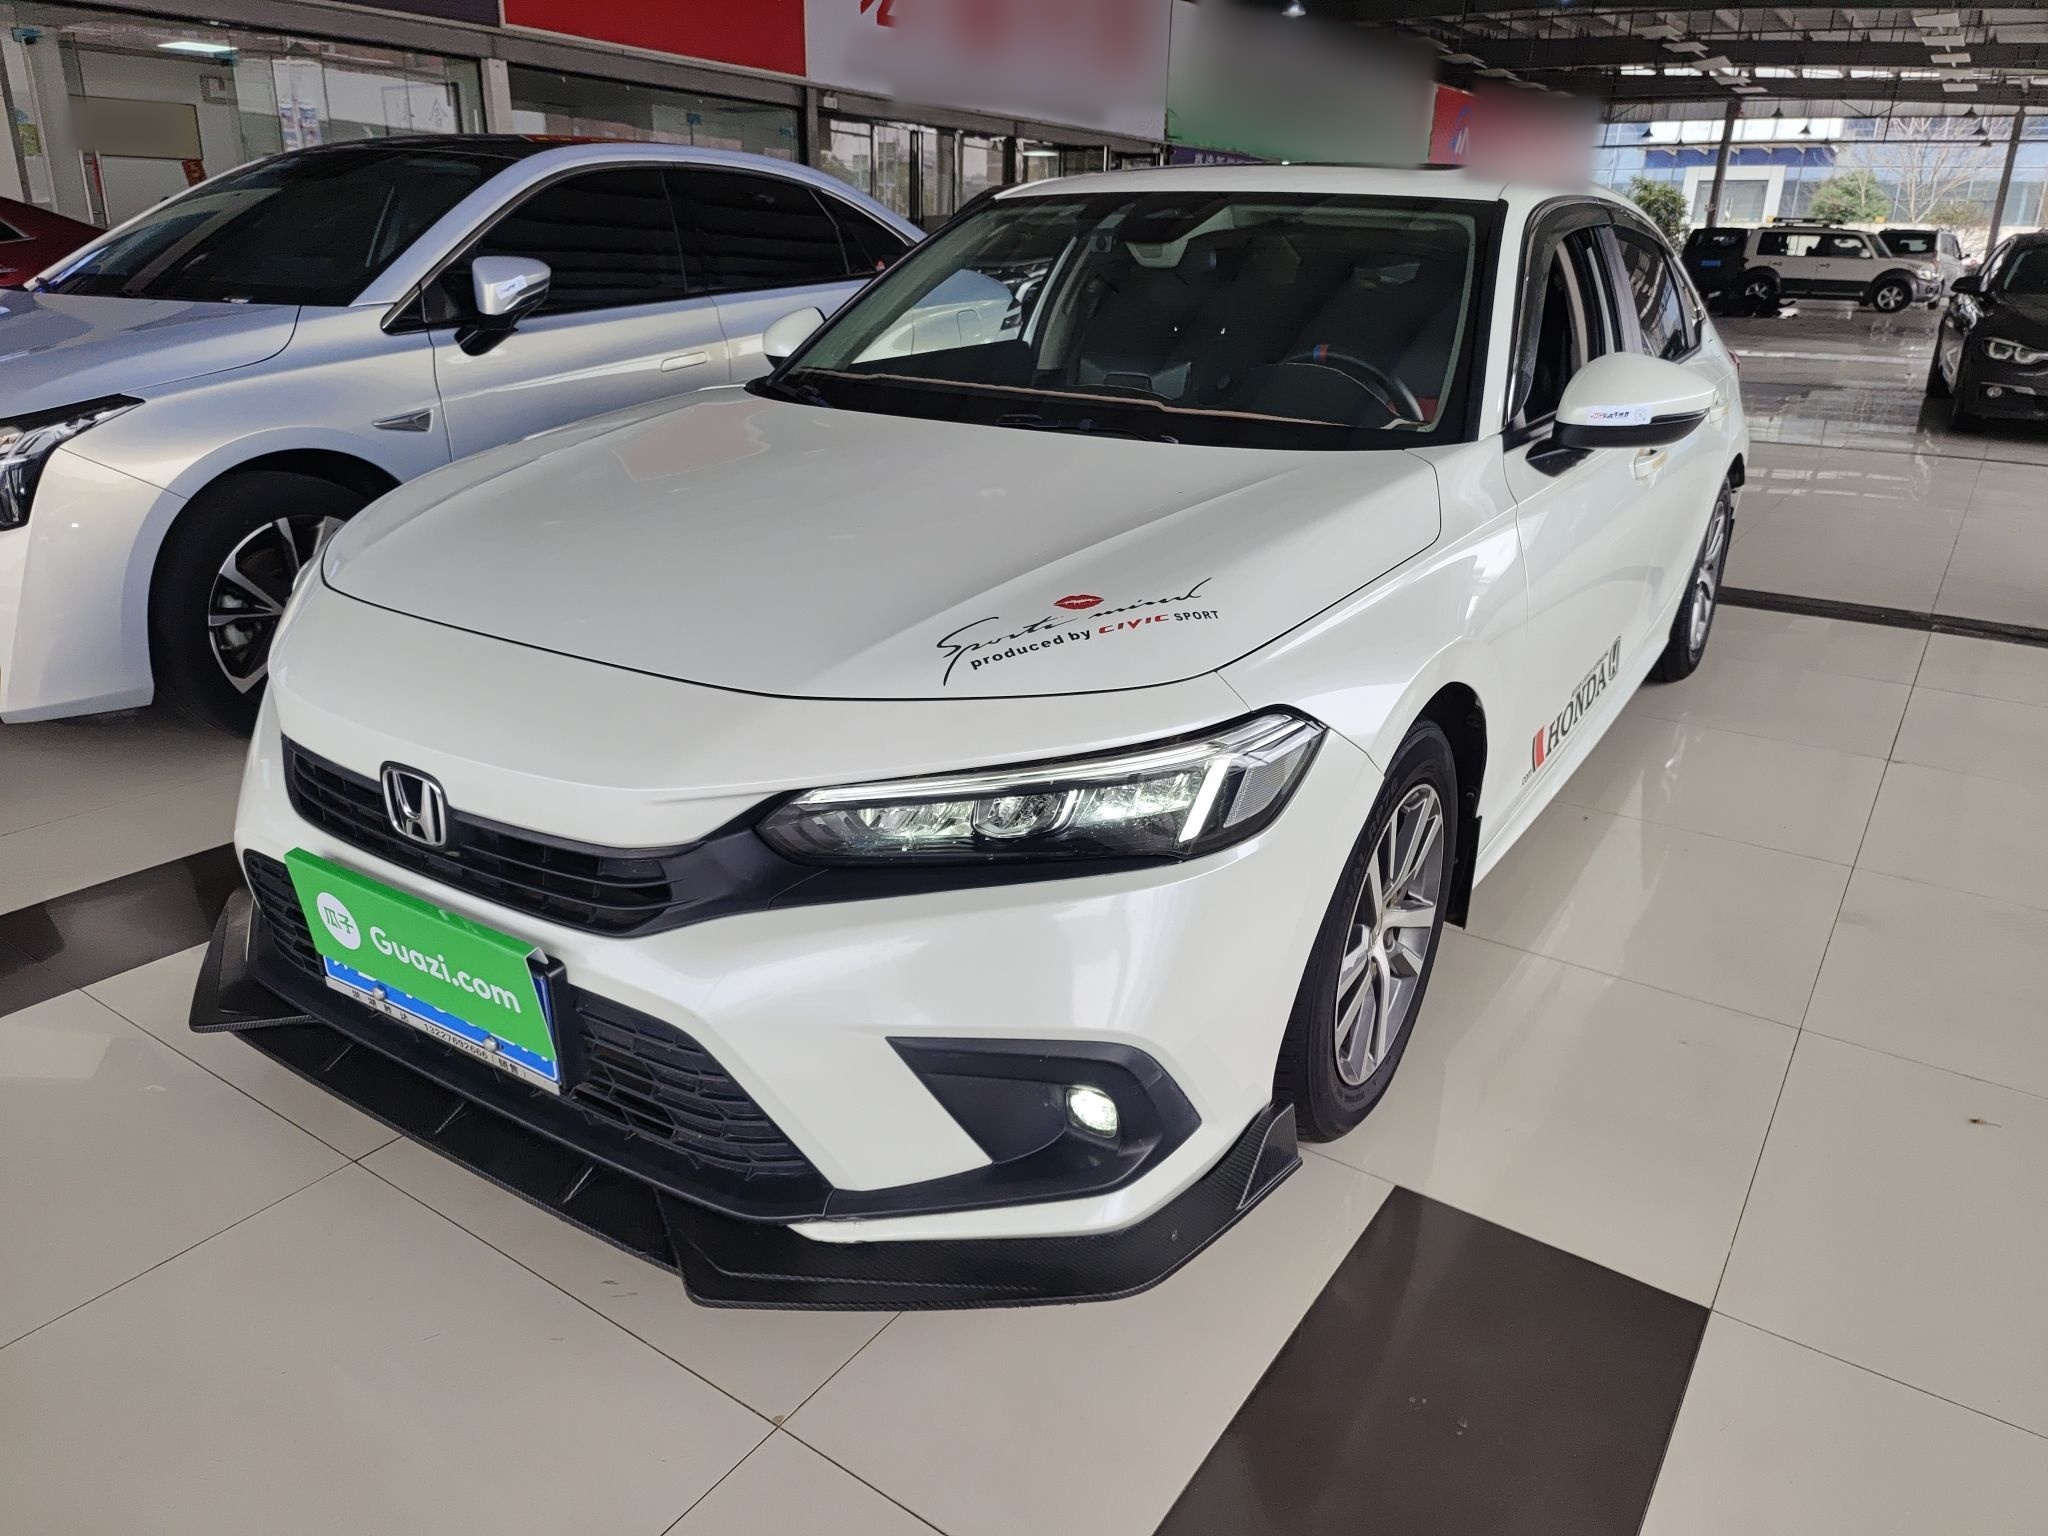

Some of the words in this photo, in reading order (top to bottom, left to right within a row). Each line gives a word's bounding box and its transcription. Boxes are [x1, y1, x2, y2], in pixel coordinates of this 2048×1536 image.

[970, 635, 1065, 671] produced
[1067, 629, 1091, 651] by
[1098, 614, 1170, 634] CIVIC
[1174, 610, 1219, 622] SPORT
[1545, 661, 1607, 757] HONDA
[323, 906, 354, 935] 瓜子
[369, 926, 522, 1014] Guazi.com
